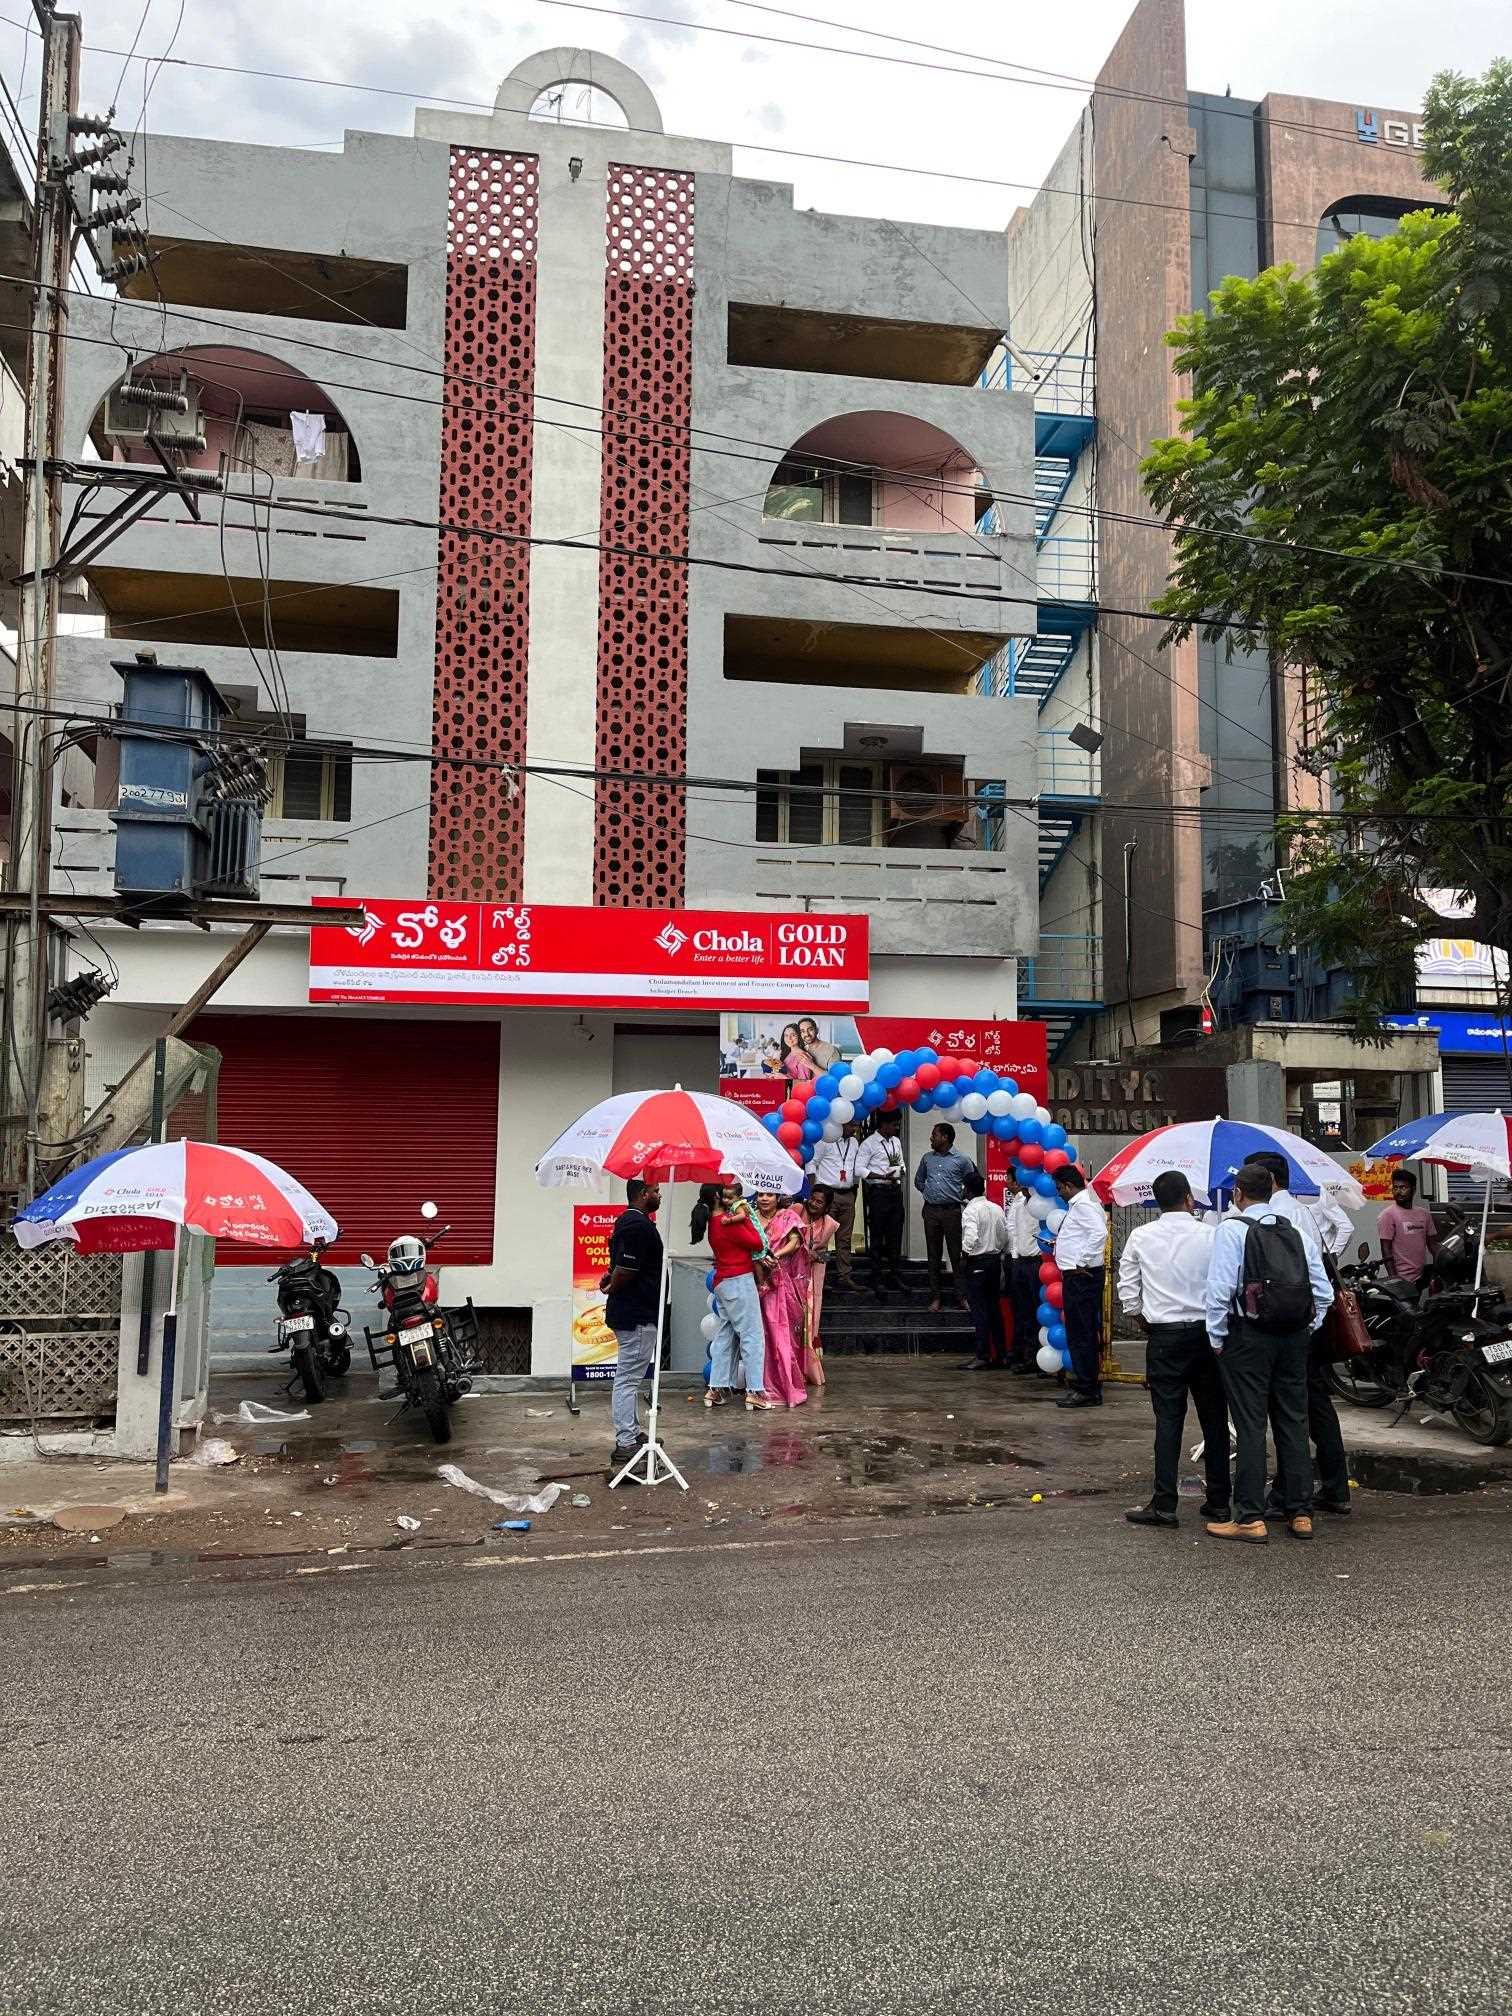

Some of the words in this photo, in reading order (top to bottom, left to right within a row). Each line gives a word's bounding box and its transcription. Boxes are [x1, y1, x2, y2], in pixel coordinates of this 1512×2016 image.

[391, 905, 468, 949] చోళ
[492, 907, 532, 941] గోల్డ్
[777, 923, 848, 945] GOLD
[693, 929, 764, 952] Chola
[491, 943, 531, 967] లోన్
[693, 953, 717, 962] Enter
[725, 954, 750, 963] better
[751, 954, 765, 965] life
[778, 946, 847, 967] LOAN
[776, 982, 805, 990] Company
[946, 1030, 976, 1048] చోళ
[1056, 1108, 1177, 1131] ARTMENT
[116, 1188, 141, 1196] Chola
[760, 1181, 782, 1190] GOLD
[578, 1235, 606, 1245] YOUR
